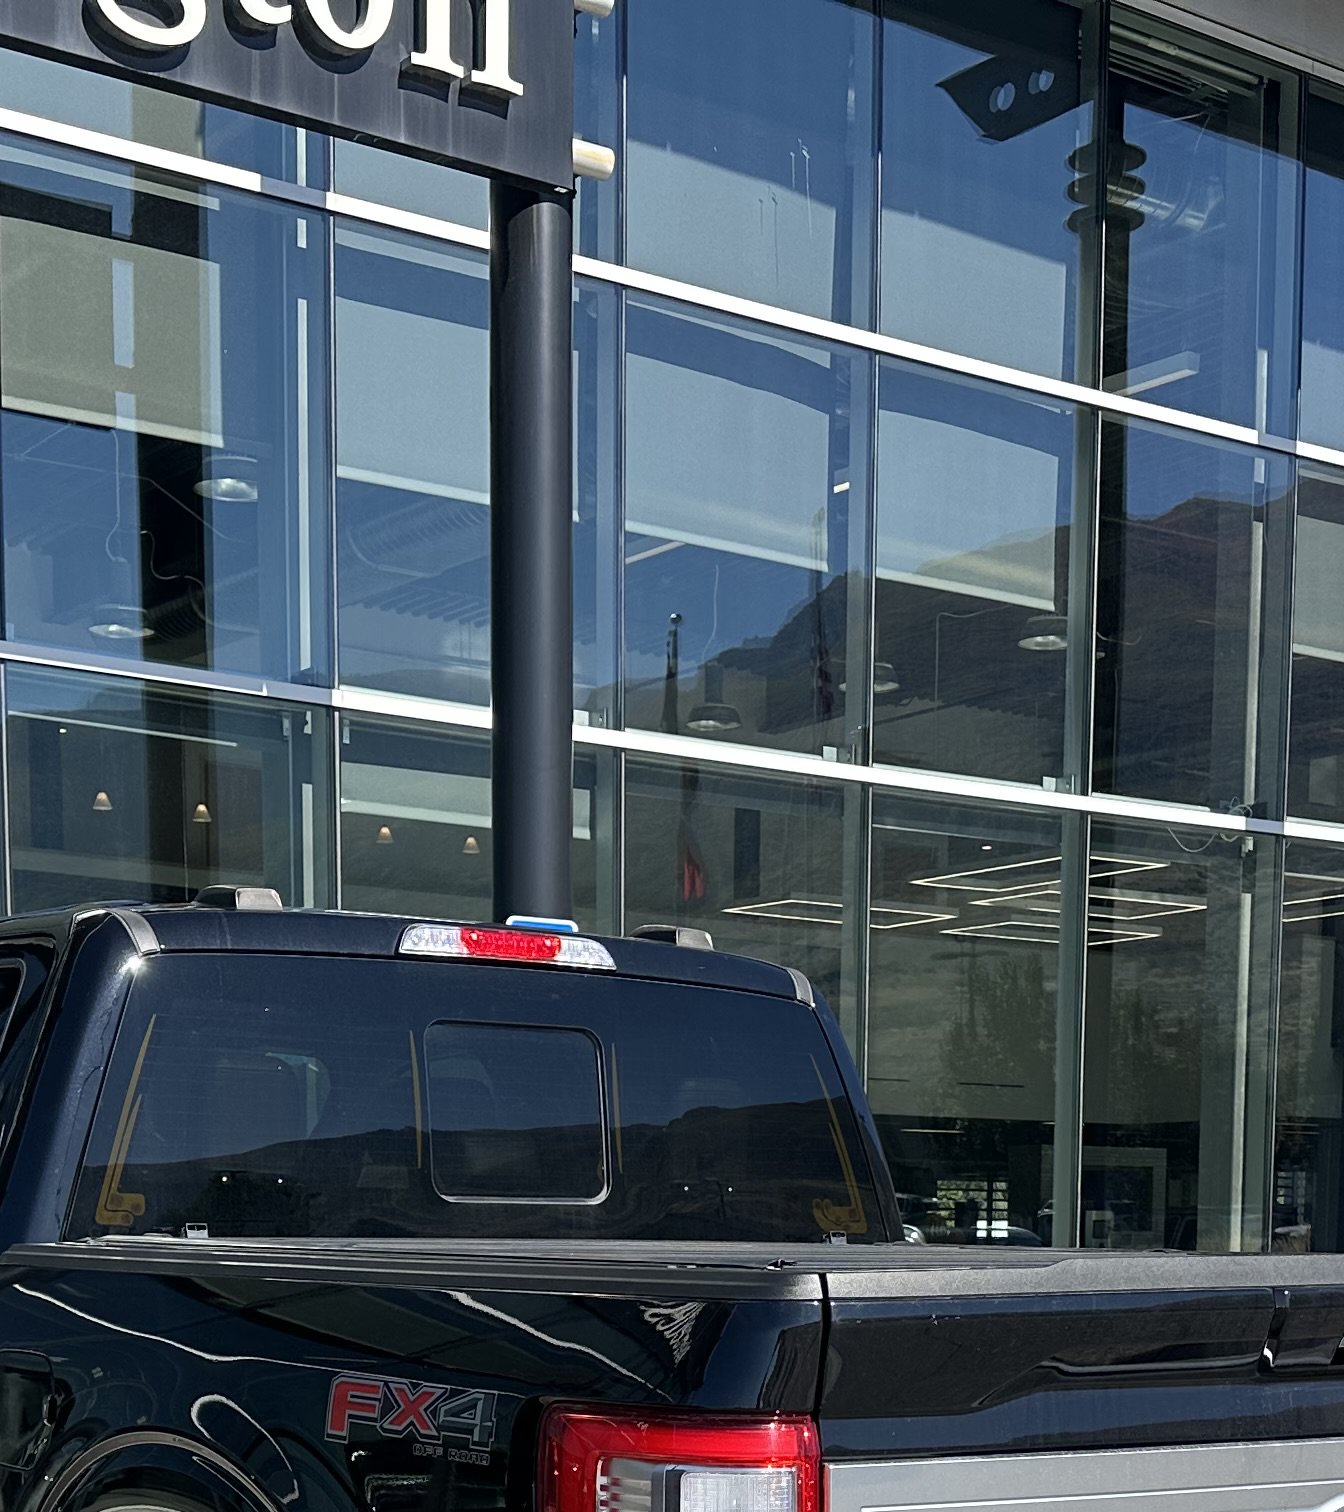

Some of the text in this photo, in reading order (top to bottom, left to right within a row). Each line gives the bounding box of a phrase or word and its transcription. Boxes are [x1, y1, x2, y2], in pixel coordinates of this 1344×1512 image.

[324, 1373, 497, 1450] FX4
[412, 1443, 491, 1466] OFF ROAD
